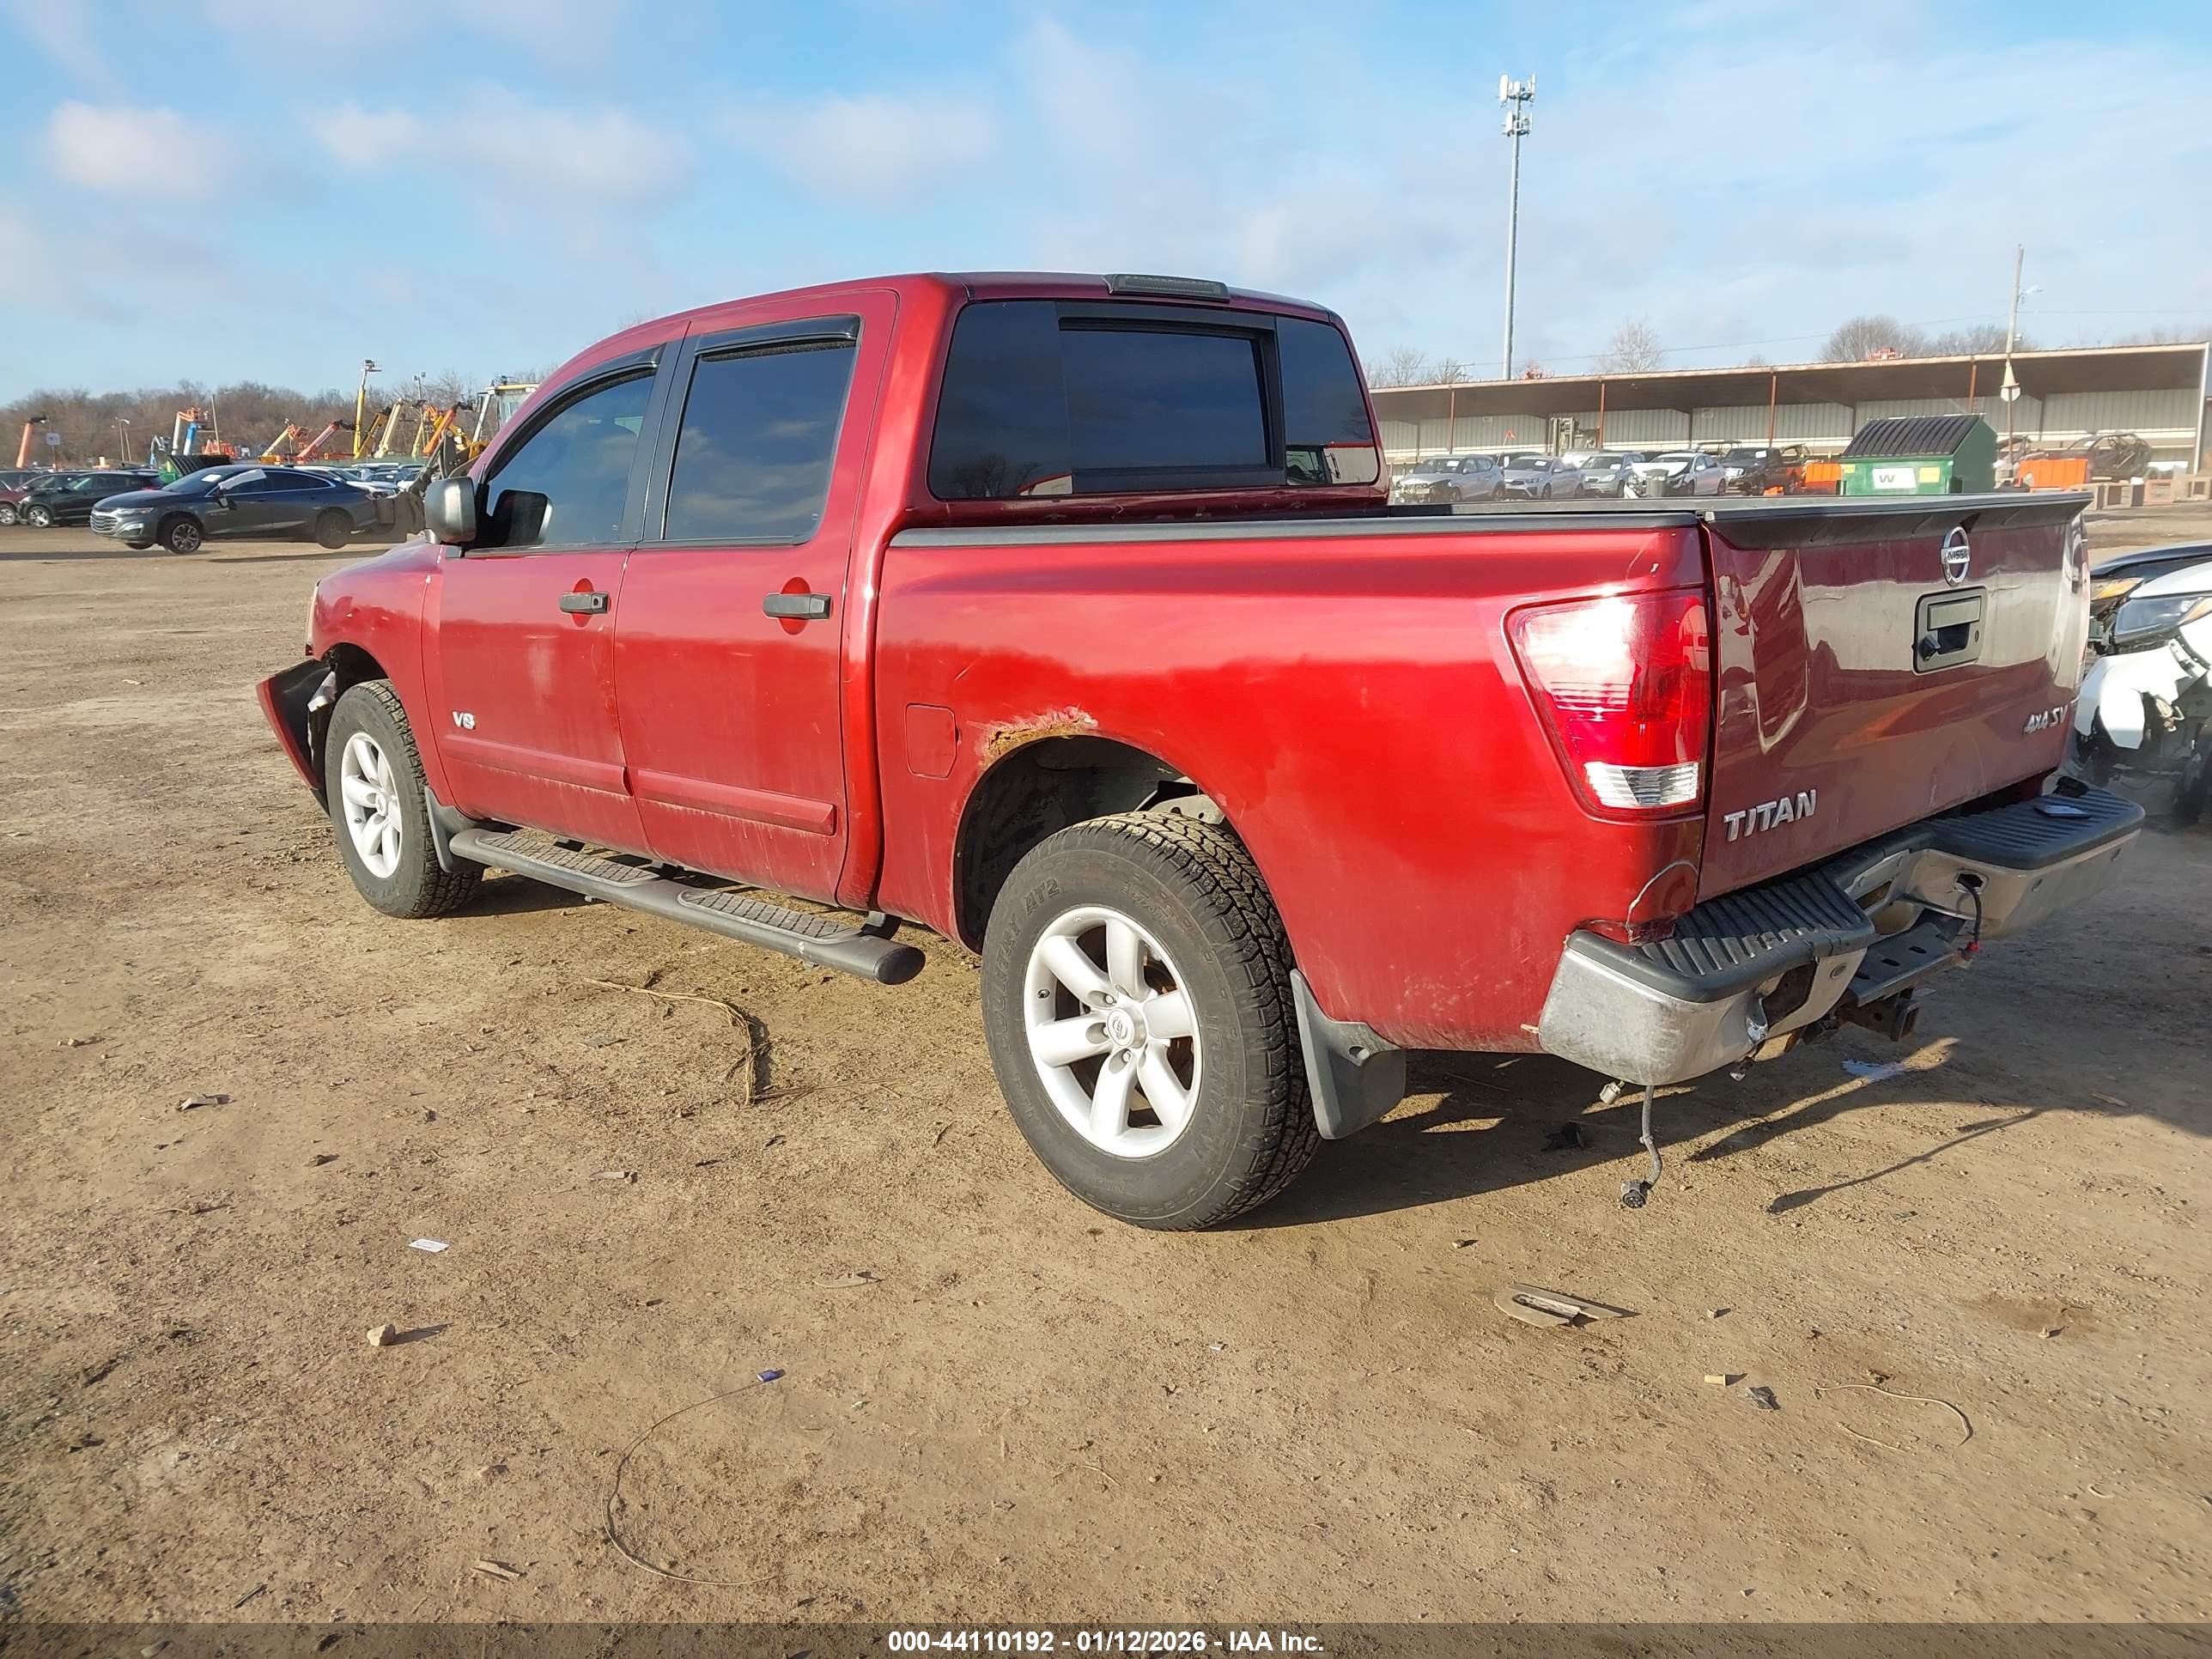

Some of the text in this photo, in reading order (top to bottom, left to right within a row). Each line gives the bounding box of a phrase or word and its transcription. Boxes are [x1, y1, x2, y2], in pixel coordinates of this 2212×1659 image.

[453, 711, 475, 730] V8
[2049, 704, 2069, 728] SV
[1723, 789, 1817, 842] TITAN
[1024, 878, 1060, 915] AT2
